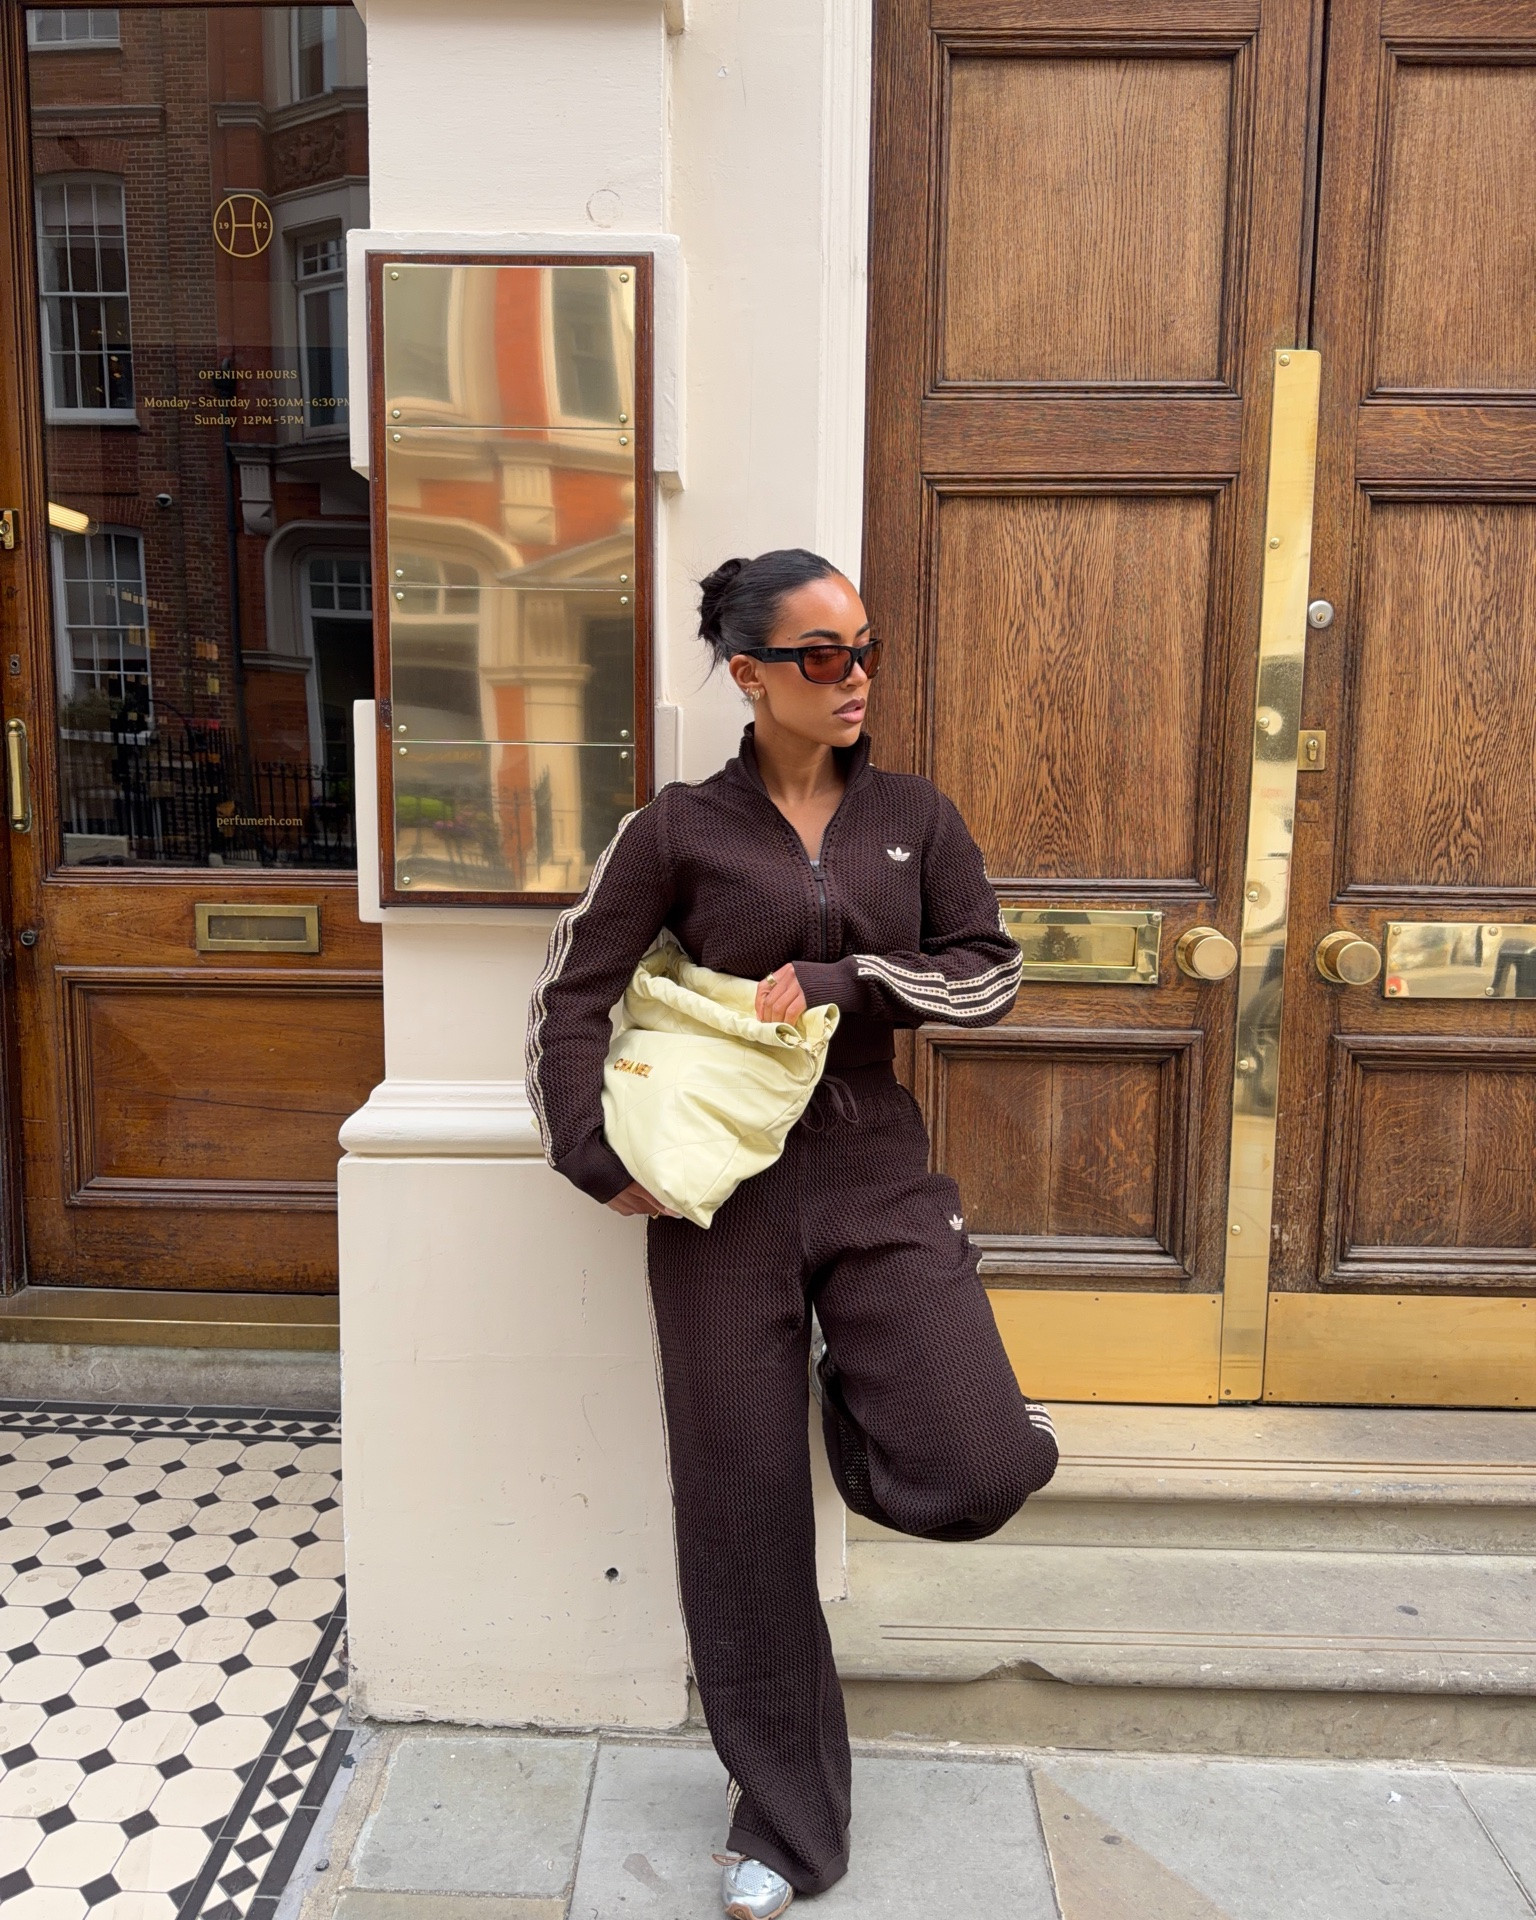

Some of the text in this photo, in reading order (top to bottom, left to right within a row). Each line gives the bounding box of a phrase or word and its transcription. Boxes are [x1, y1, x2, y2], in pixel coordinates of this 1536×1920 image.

[198, 370, 298, 379] OPENING HOURS
[194, 414, 237, 427] Sunday
[216, 815, 303, 828] perfumerh.com
[613, 1058, 653, 1078] CHANEL
